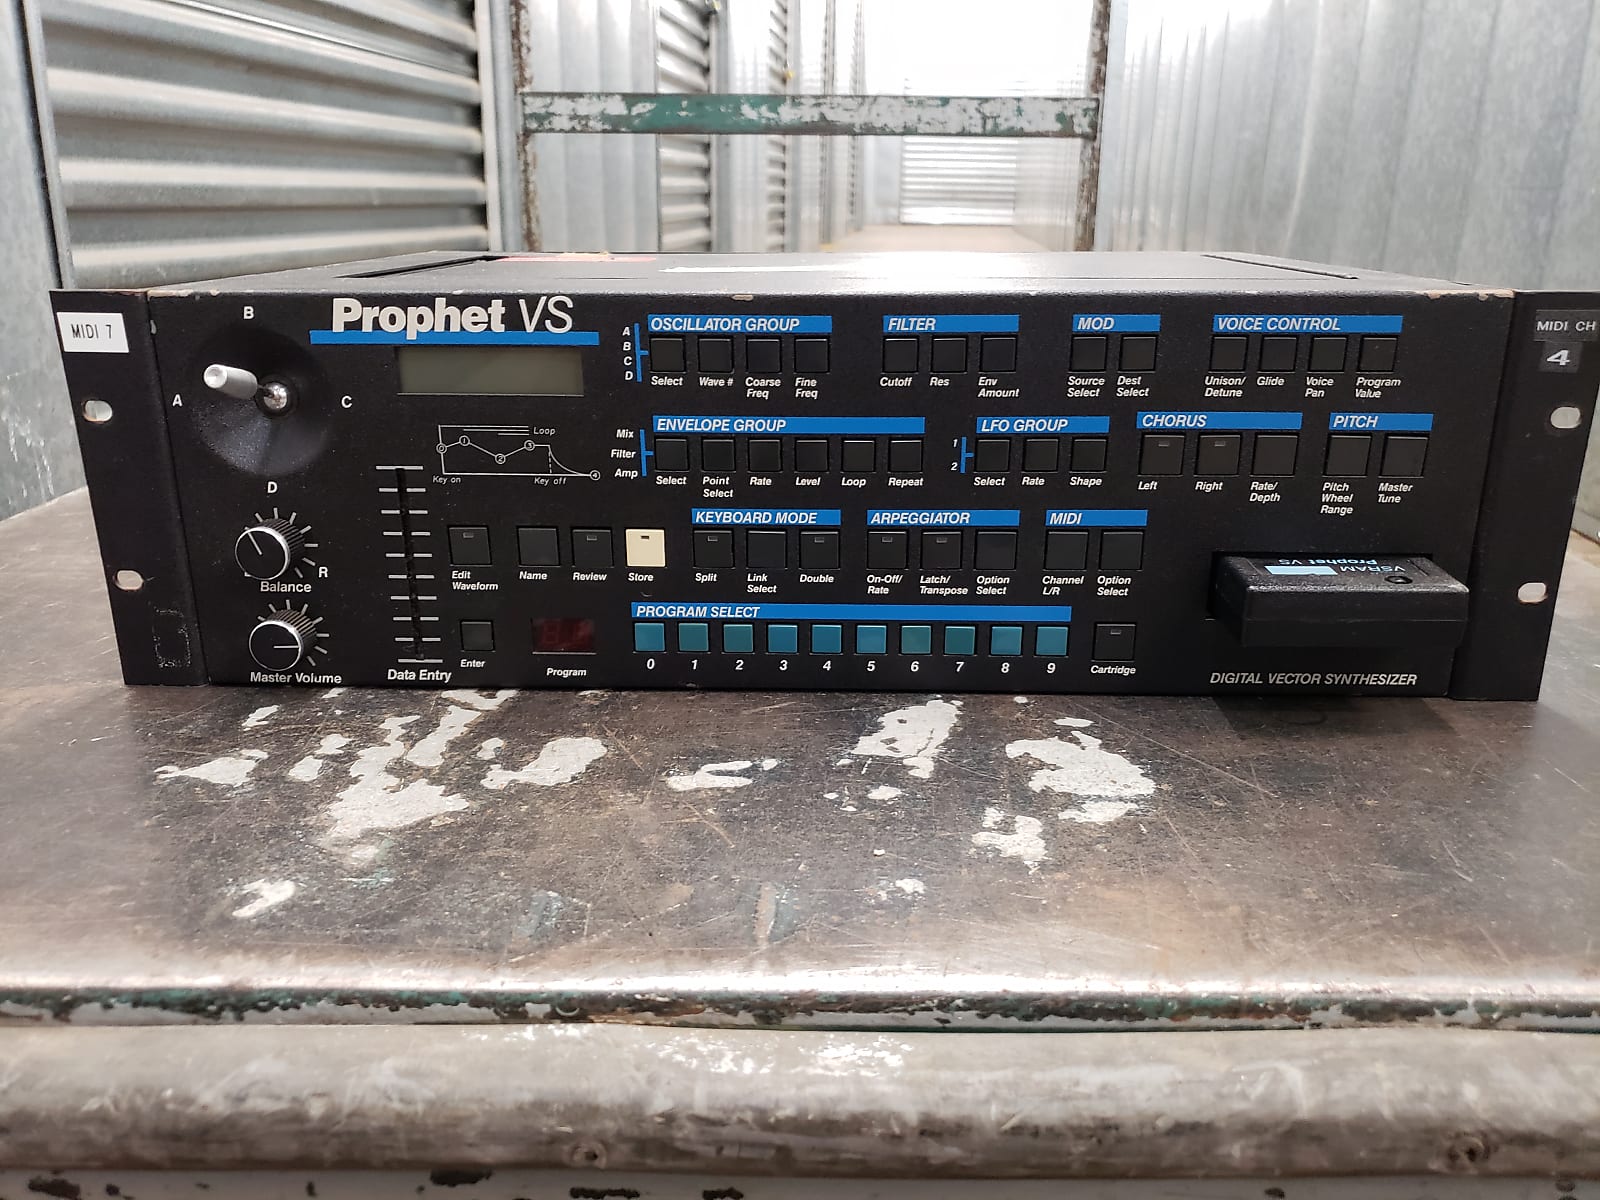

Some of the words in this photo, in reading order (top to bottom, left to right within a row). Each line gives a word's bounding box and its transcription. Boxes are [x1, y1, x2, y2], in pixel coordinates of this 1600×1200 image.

[244, 306, 254, 319] B
[333, 298, 505, 340] Prophet
[519, 294, 575, 333] VS
[651, 318, 741, 331] OSCILLATOR
[746, 318, 799, 331] GROUP
[888, 318, 936, 330] FILTER
[1078, 317, 1114, 330] MOD
[1218, 318, 1264, 330] VOICE
[1267, 318, 1340, 330] CONTROL
[1537, 321, 1568, 330] MIDI
[1576, 321, 1596, 331] CH
[71, 324, 98, 338] MIDI
[106, 325, 112, 338] 7
[1547, 350, 1570, 365] 4
[625, 371, 633, 380] D
[651, 376, 683, 385] Select
[1068, 376, 1105, 385] Source
[1117, 376, 1141, 385] Dest
[1205, 376, 1246, 385] Unison/
[700, 377, 724, 386] Wave
[746, 377, 781, 388] Coarse
[795, 378, 817, 386] Fine
[880, 377, 912, 386] Cutoff
[930, 377, 949, 386] Res
[979, 377, 997, 385] Env
[1257, 377, 1284, 386] Glide
[1306, 377, 1333, 385] Voice
[1356, 377, 1401, 388] Program
[747, 389, 769, 399] Freq
[796, 389, 818, 399] Freq
[978, 388, 1019, 397] Amount
[1067, 388, 1099, 397] Select
[1117, 388, 1149, 396] Select
[1205, 388, 1242, 396] Detune
[1305, 388, 1324, 397] Pan
[1356, 388, 1381, 398] Value
[173, 395, 182, 406] A
[342, 396, 352, 408] C
[658, 419, 730, 431] ENVELOPE
[734, 419, 786, 431] GROUP
[982, 420, 1009, 431] LFO
[1014, 419, 1068, 431] GROUP
[1143, 415, 1207, 427] CHORUS
[1334, 416, 1378, 427] PITCH
[534, 427, 555, 436] Loop
[617, 429, 633, 438] Mix
[611, 449, 636, 458] Filter
[433, 474, 448, 484] Key
[450, 474, 462, 483] on
[615, 469, 638, 479] Amp
[533, 476, 550, 486] Key
[552, 476, 568, 484] off
[656, 476, 686, 484] Select
[750, 477, 771, 485] Rate
[796, 477, 820, 485] Level
[842, 477, 866, 488] Loop
[888, 478, 923, 488] Repeat
[974, 477, 1005, 485] Select
[1022, 477, 1044, 485] Rate
[1070, 477, 1102, 487] Shape
[268, 482, 277, 493] D
[1138, 481, 1157, 490] Left
[1195, 482, 1223, 492] Right
[1251, 482, 1278, 492] Rate/
[1323, 482, 1349, 491] Pitch
[1379, 483, 1413, 494] Master
[703, 489, 733, 498] Select
[1250, 493, 1280, 503] Depth
[1322, 494, 1353, 502] Wheel
[1378, 494, 1401, 503] Tune
[1321, 505, 1353, 516] Range
[696, 512, 772, 523] KEYBOARD
[776, 512, 817, 523] MODE
[871, 512, 970, 524] ARPEGGIATOR
[1050, 513, 1082, 524] MIDI
[319, 567, 328, 577] R
[452, 571, 470, 579] Edit
[520, 571, 547, 580] Name
[573, 572, 607, 580] Review
[628, 573, 653, 581] Store
[696, 573, 717, 583] Split
[748, 574, 767, 582] Link
[800, 574, 834, 582] Double
[867, 575, 903, 586] On-Off/
[920, 576, 950, 586] Latch/
[977, 576, 1009, 587] Option
[1043, 576, 1084, 586] Channel
[1098, 576, 1131, 587] Option
[261, 580, 311, 592] Balance
[453, 582, 498, 590] Waveform
[868, 586, 889, 594] Rate
[920, 586, 968, 596] Transpose
[976, 585, 1006, 594] Select
[1097, 586, 1128, 596] Select
[1043, 587, 1060, 596] L/R
[637, 606, 707, 617] PROGRAM
[711, 607, 760, 617] SELECT
[461, 659, 485, 667] Enter
[647, 659, 654, 669] 0
[692, 660, 698, 669] 1
[736, 660, 744, 670] 2
[780, 660, 787, 670] 3
[823, 661, 831, 670] 4
[867, 661, 875, 671] 5
[911, 661, 919, 671] 6
[957, 662, 964, 672] 7
[1001, 663, 1009, 673] 8
[1047, 663, 1055, 673] 9
[547, 668, 586, 678] Program
[1091, 665, 1136, 675] Cartridge
[251, 671, 292, 682] Master
[295, 673, 341, 683] Volume
[388, 669, 416, 680] Data
[419, 669, 451, 683] Entry
[1210, 673, 1262, 683] DIGITAL
[1268, 673, 1321, 684] VECTOR
[1324, 674, 1417, 685] SYNTHESIZER
